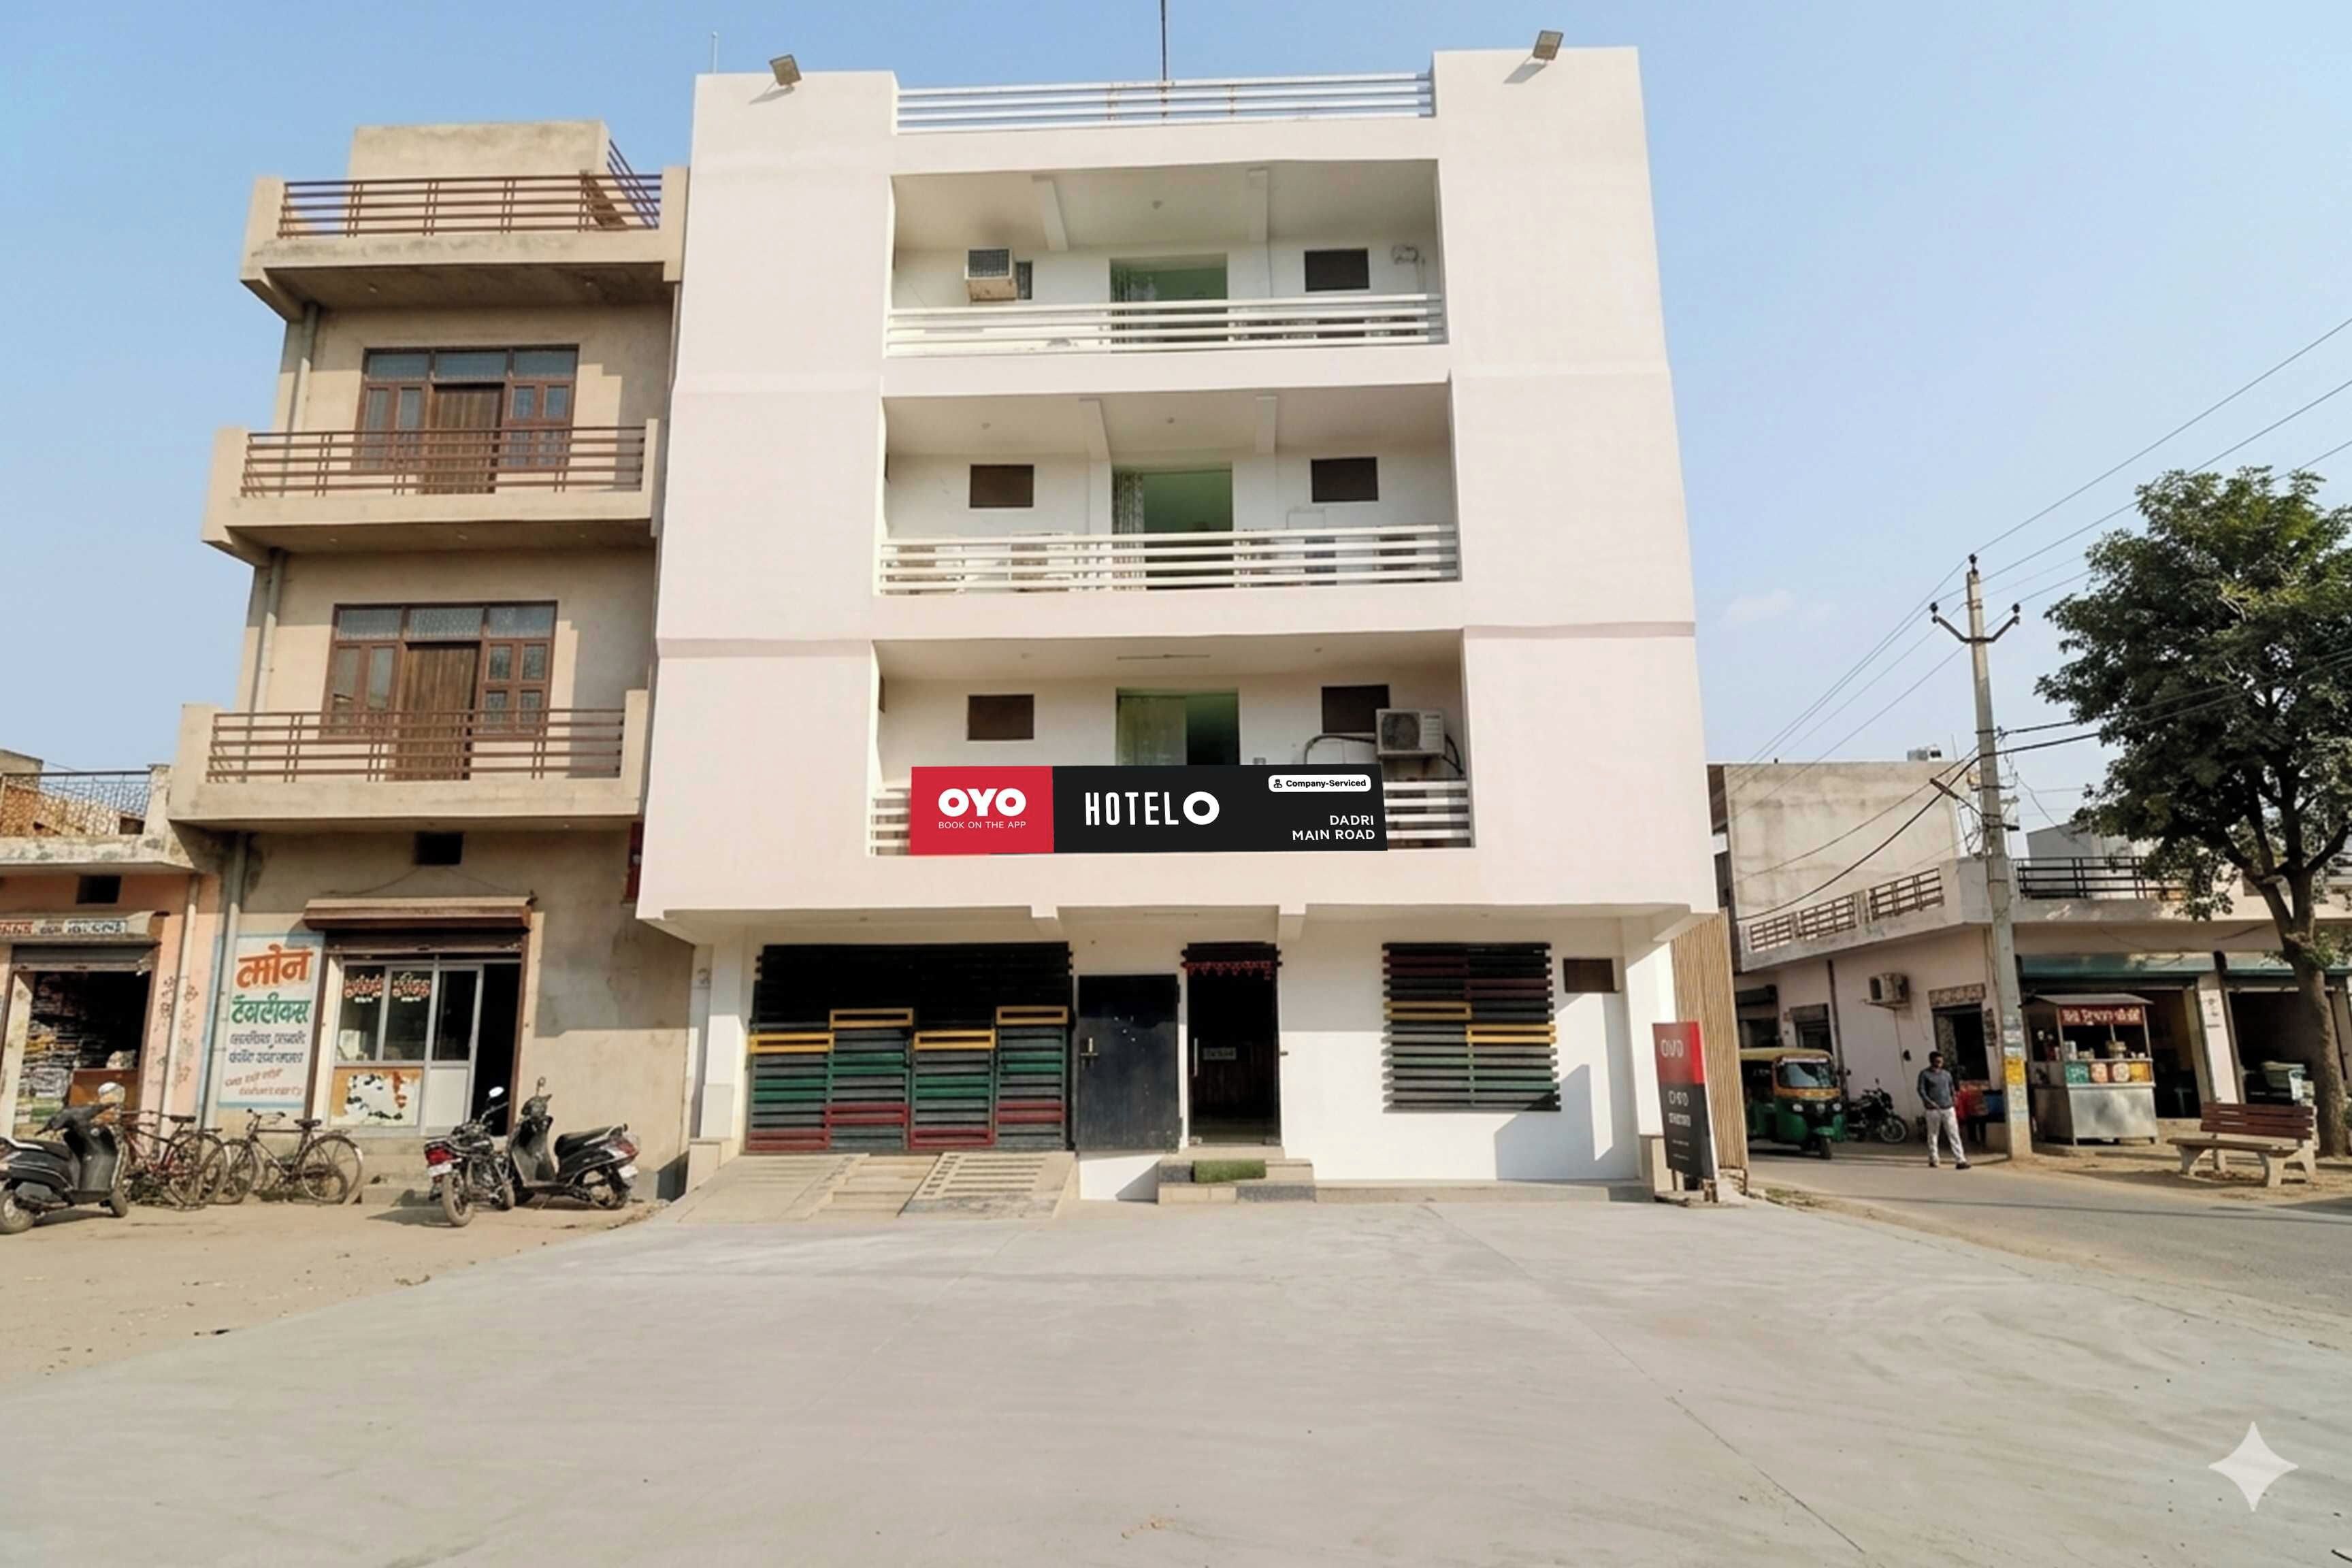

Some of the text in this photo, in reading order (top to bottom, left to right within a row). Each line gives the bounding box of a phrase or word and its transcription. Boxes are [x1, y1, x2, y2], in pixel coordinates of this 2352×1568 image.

[1286, 779, 1366, 788] Company-Serviced
[938, 788, 1026, 817] OYO
[1330, 815, 1374, 826] DADRI
[1292, 830, 1375, 840] MAIN ROAD
